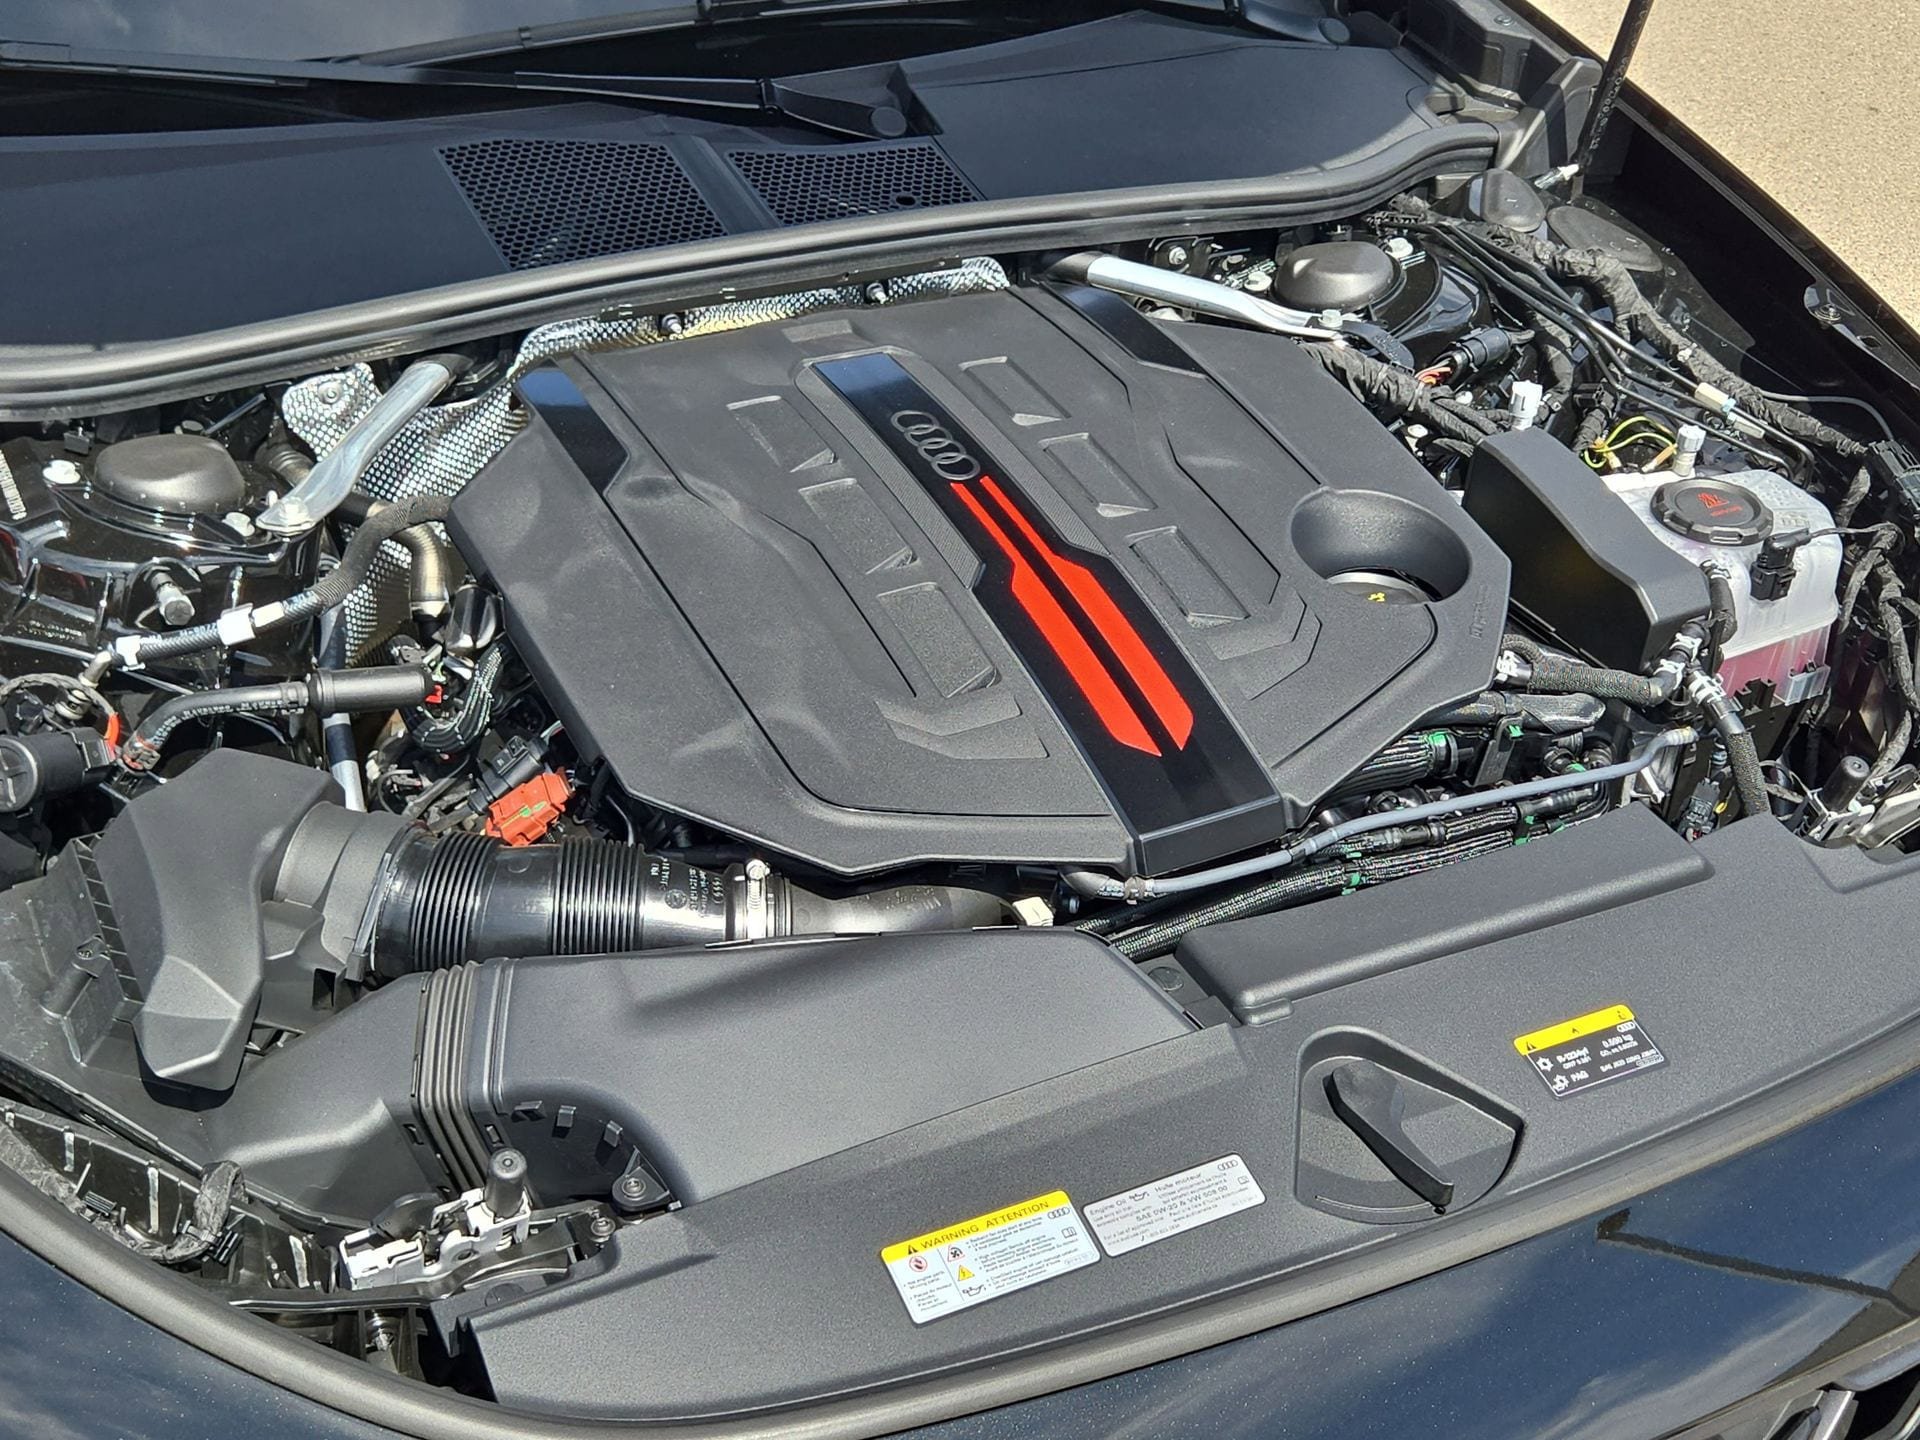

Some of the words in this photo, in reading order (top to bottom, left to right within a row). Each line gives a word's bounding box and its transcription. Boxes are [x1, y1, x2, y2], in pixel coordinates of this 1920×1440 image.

[1175, 1172, 1202, 1186] moteur
[1090, 1202, 1115, 1216] Engine
[1116, 1198, 1127, 1206] Oil
[1135, 1211, 1153, 1221] SAE
[1186, 1193, 1202, 1203] VW
[921, 1224, 980, 1250] WARNING
[986, 1201, 1050, 1228] ATTENTION
